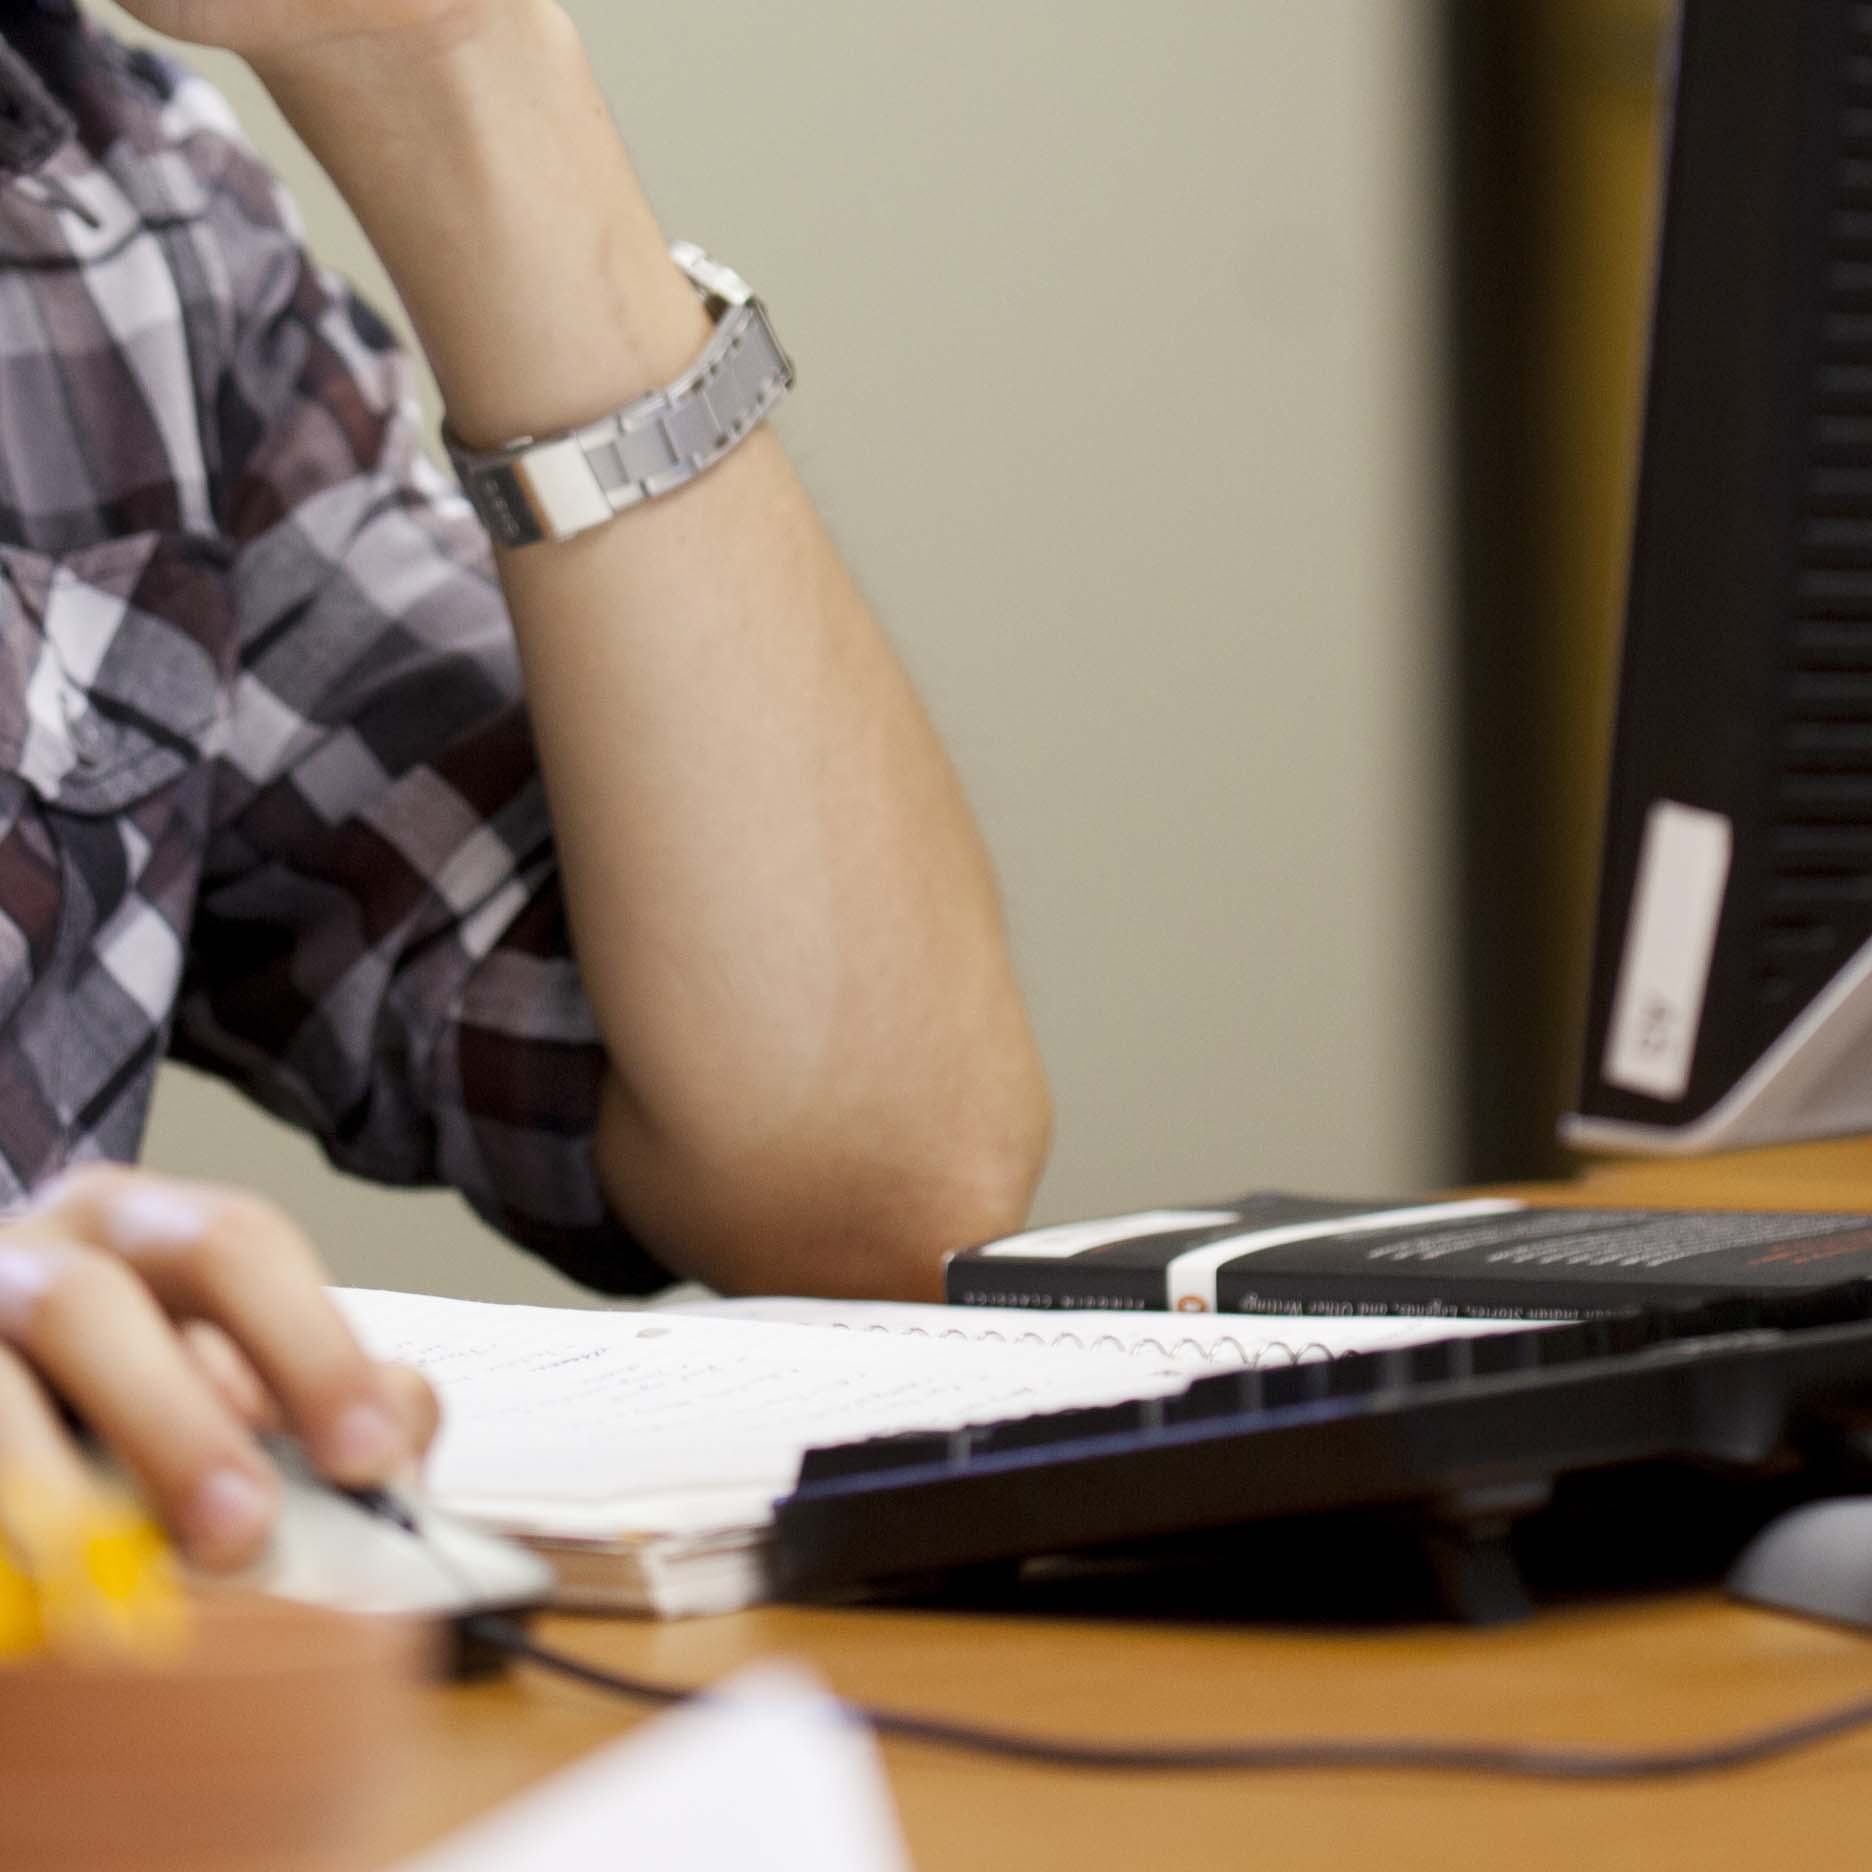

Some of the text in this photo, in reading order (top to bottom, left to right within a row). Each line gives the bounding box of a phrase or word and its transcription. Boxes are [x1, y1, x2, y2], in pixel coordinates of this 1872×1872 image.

[1309, 1299, 1354, 1316] Other
[1358, 1300, 1388, 1317] and
[1528, 1304, 1579, 1320] Indian
